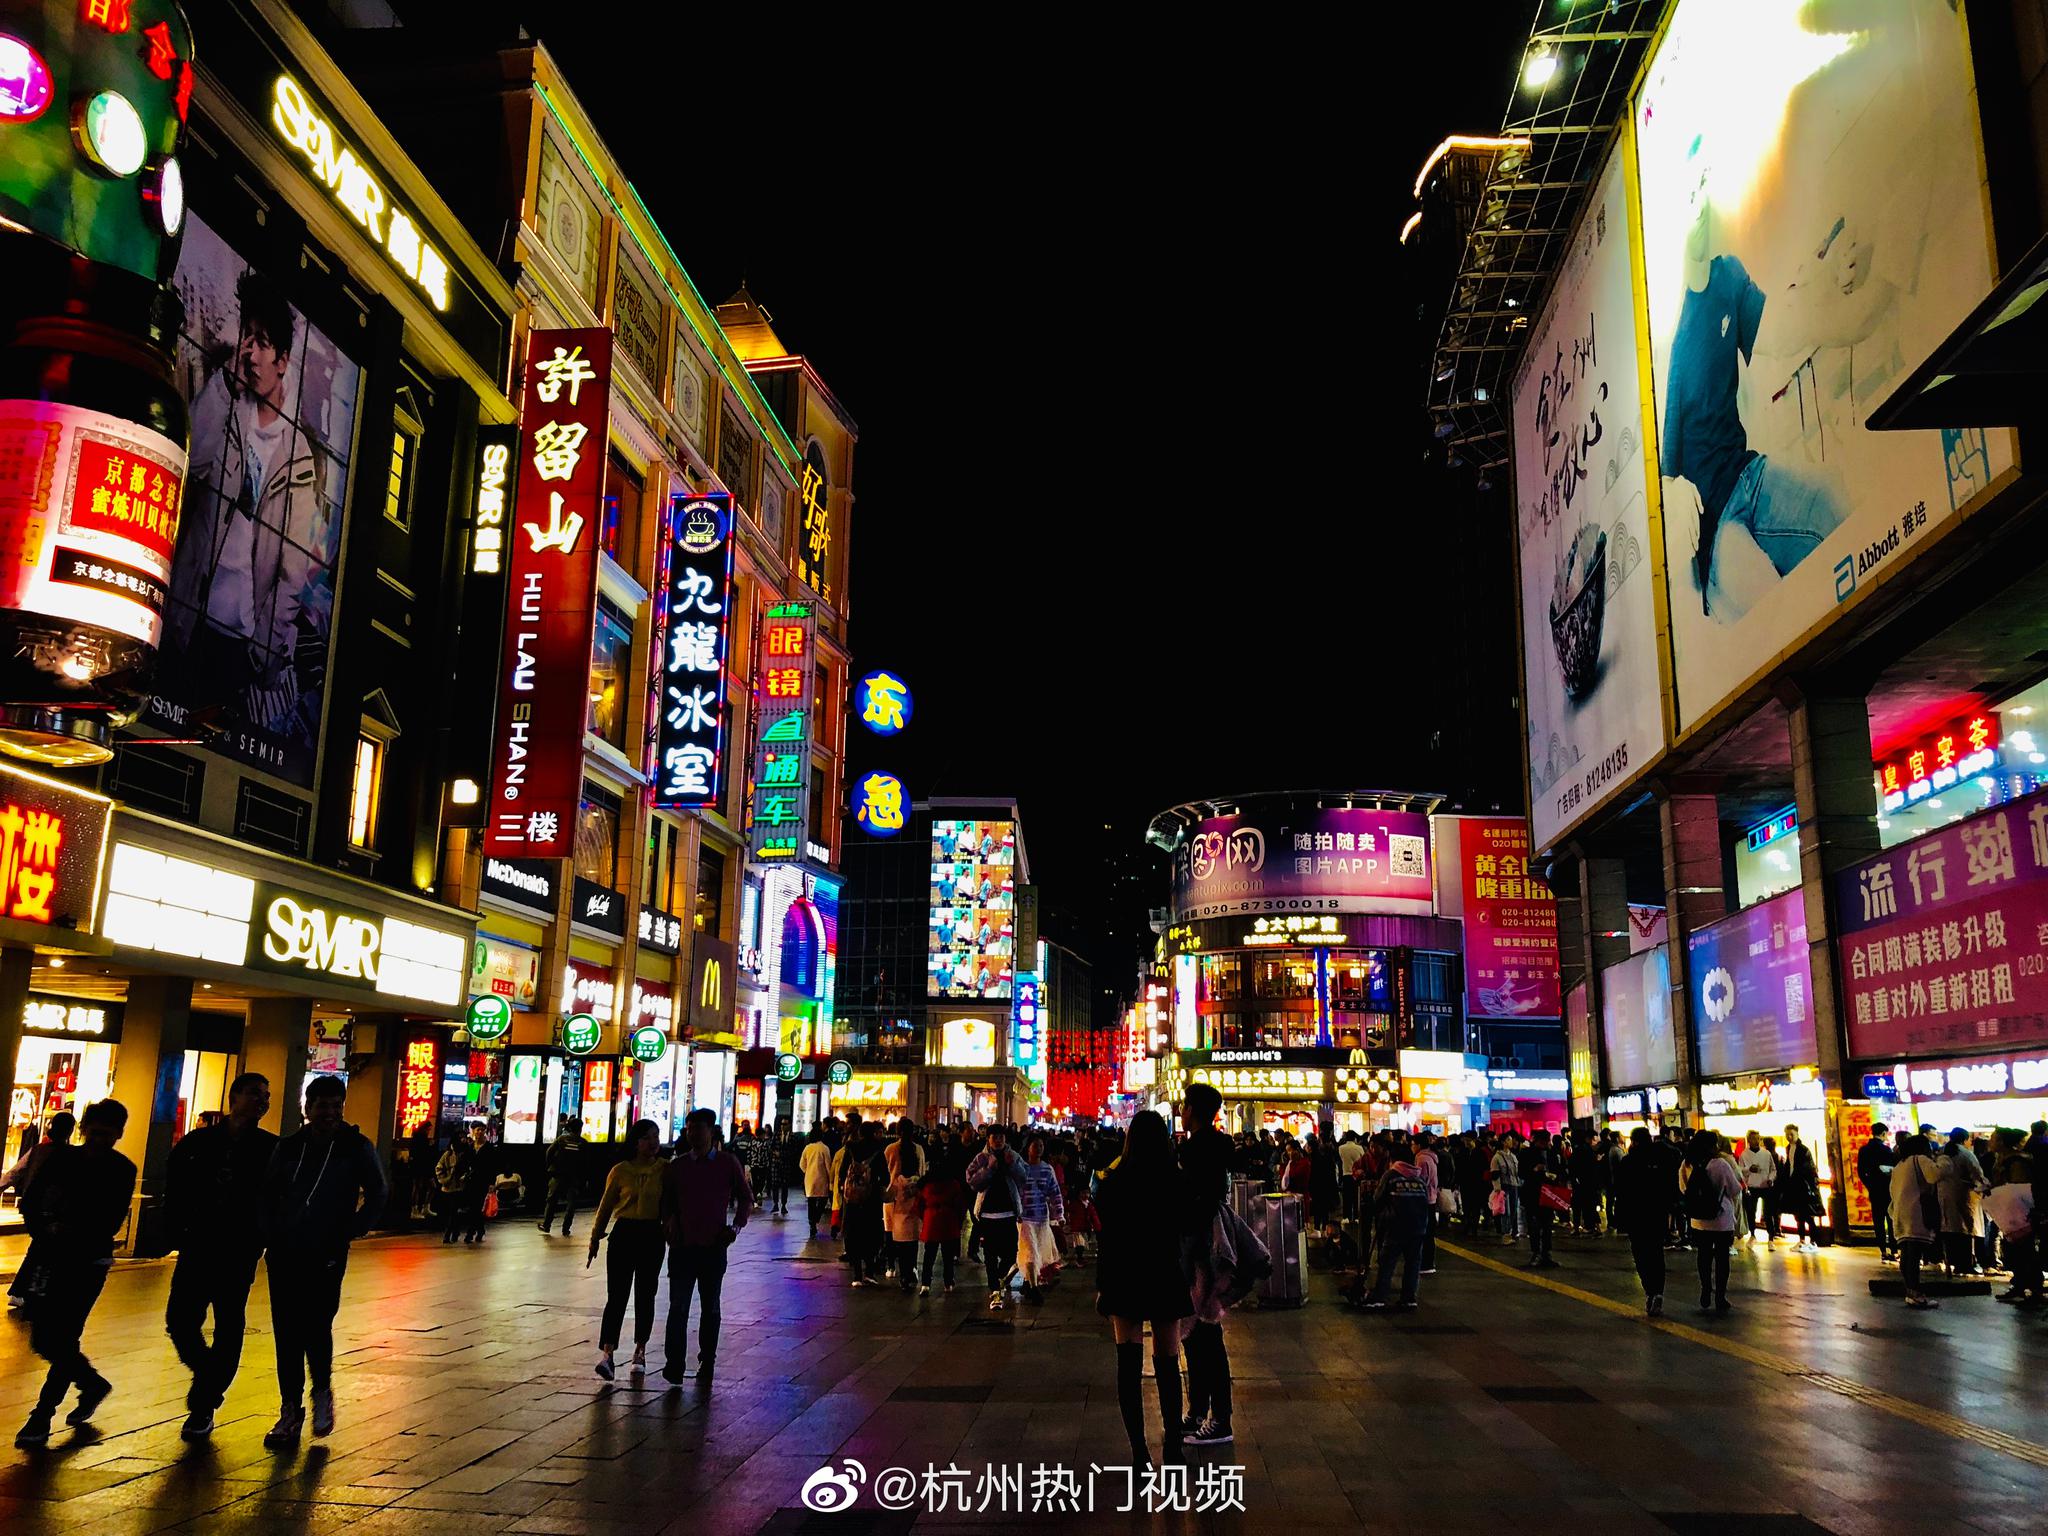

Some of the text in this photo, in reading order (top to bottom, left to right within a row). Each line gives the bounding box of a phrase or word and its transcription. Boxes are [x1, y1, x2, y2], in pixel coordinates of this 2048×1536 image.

[522, 346, 597, 554] 許留山
[1858, 500, 1927, 577] Abbott 雅培
[520, 573, 543, 622] HUI
[513, 633, 538, 690] LAU
[663, 566, 723, 797] 九龍冰室
[240, 733, 284, 767] SEMIR
[495, 811, 558, 843] 三楼
[1294, 832, 1376, 852] 随拍随卖
[487, 858, 549, 897] McDonald's
[1475, 876, 1556, 900] 隆重招
[264, 896, 381, 983] SEMIR
[638, 909, 681, 950] 麦当劳
[1851, 909, 2007, 980] 合同期满装修升级
[1855, 961, 2016, 1025] 隆重对外重新招租
[1211, 1050, 1282, 1062] McDonald's
[401, 1041, 435, 1129] 眼镜城
